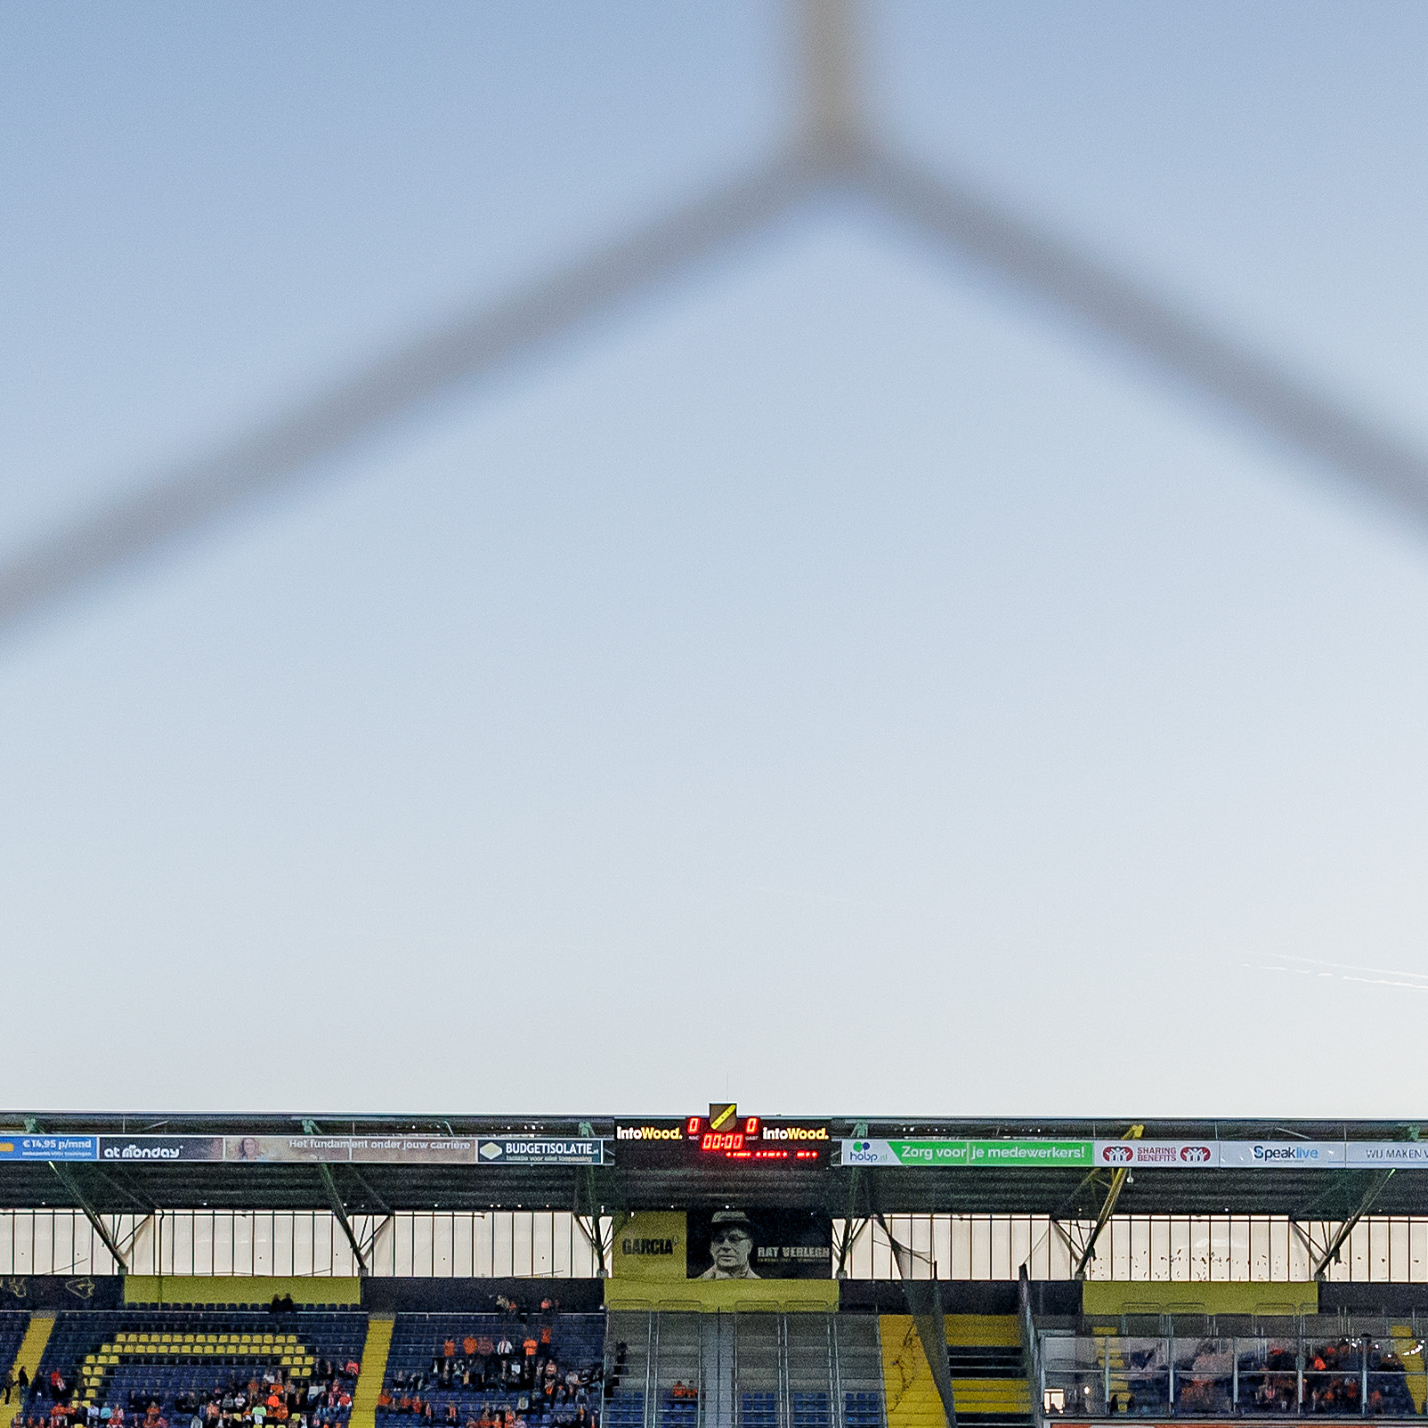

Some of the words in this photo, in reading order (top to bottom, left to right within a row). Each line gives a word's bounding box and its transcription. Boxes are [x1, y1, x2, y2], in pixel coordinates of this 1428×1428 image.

[688, 1117, 700, 1134] 0
[746, 1117, 758, 1134] 0
[58, 1139, 91, 1150] p/mnd
[289, 1140, 308, 1148] Het
[309, 1139, 368, 1148] fundament
[370, 1140, 400, 1149] onder
[403, 1140, 428, 1150] jouw
[430, 1140, 471, 1150] carrière
[702, 1133, 743, 1149] 00:00
[104, 1146, 120, 1158] at
[902, 1146, 933, 1161] Zorg
[935, 1148, 966, 1159] voor
[971, 1148, 984, 1161] je
[987, 1145, 1085, 1159] medewerkers!
[1137, 1146, 1177, 1155] SHARING
[1366, 1150, 1383, 1159] WIJ
[1386, 1150, 1421, 1159] MAKEN
[1137, 1154, 1177, 1162] BENEFITS
